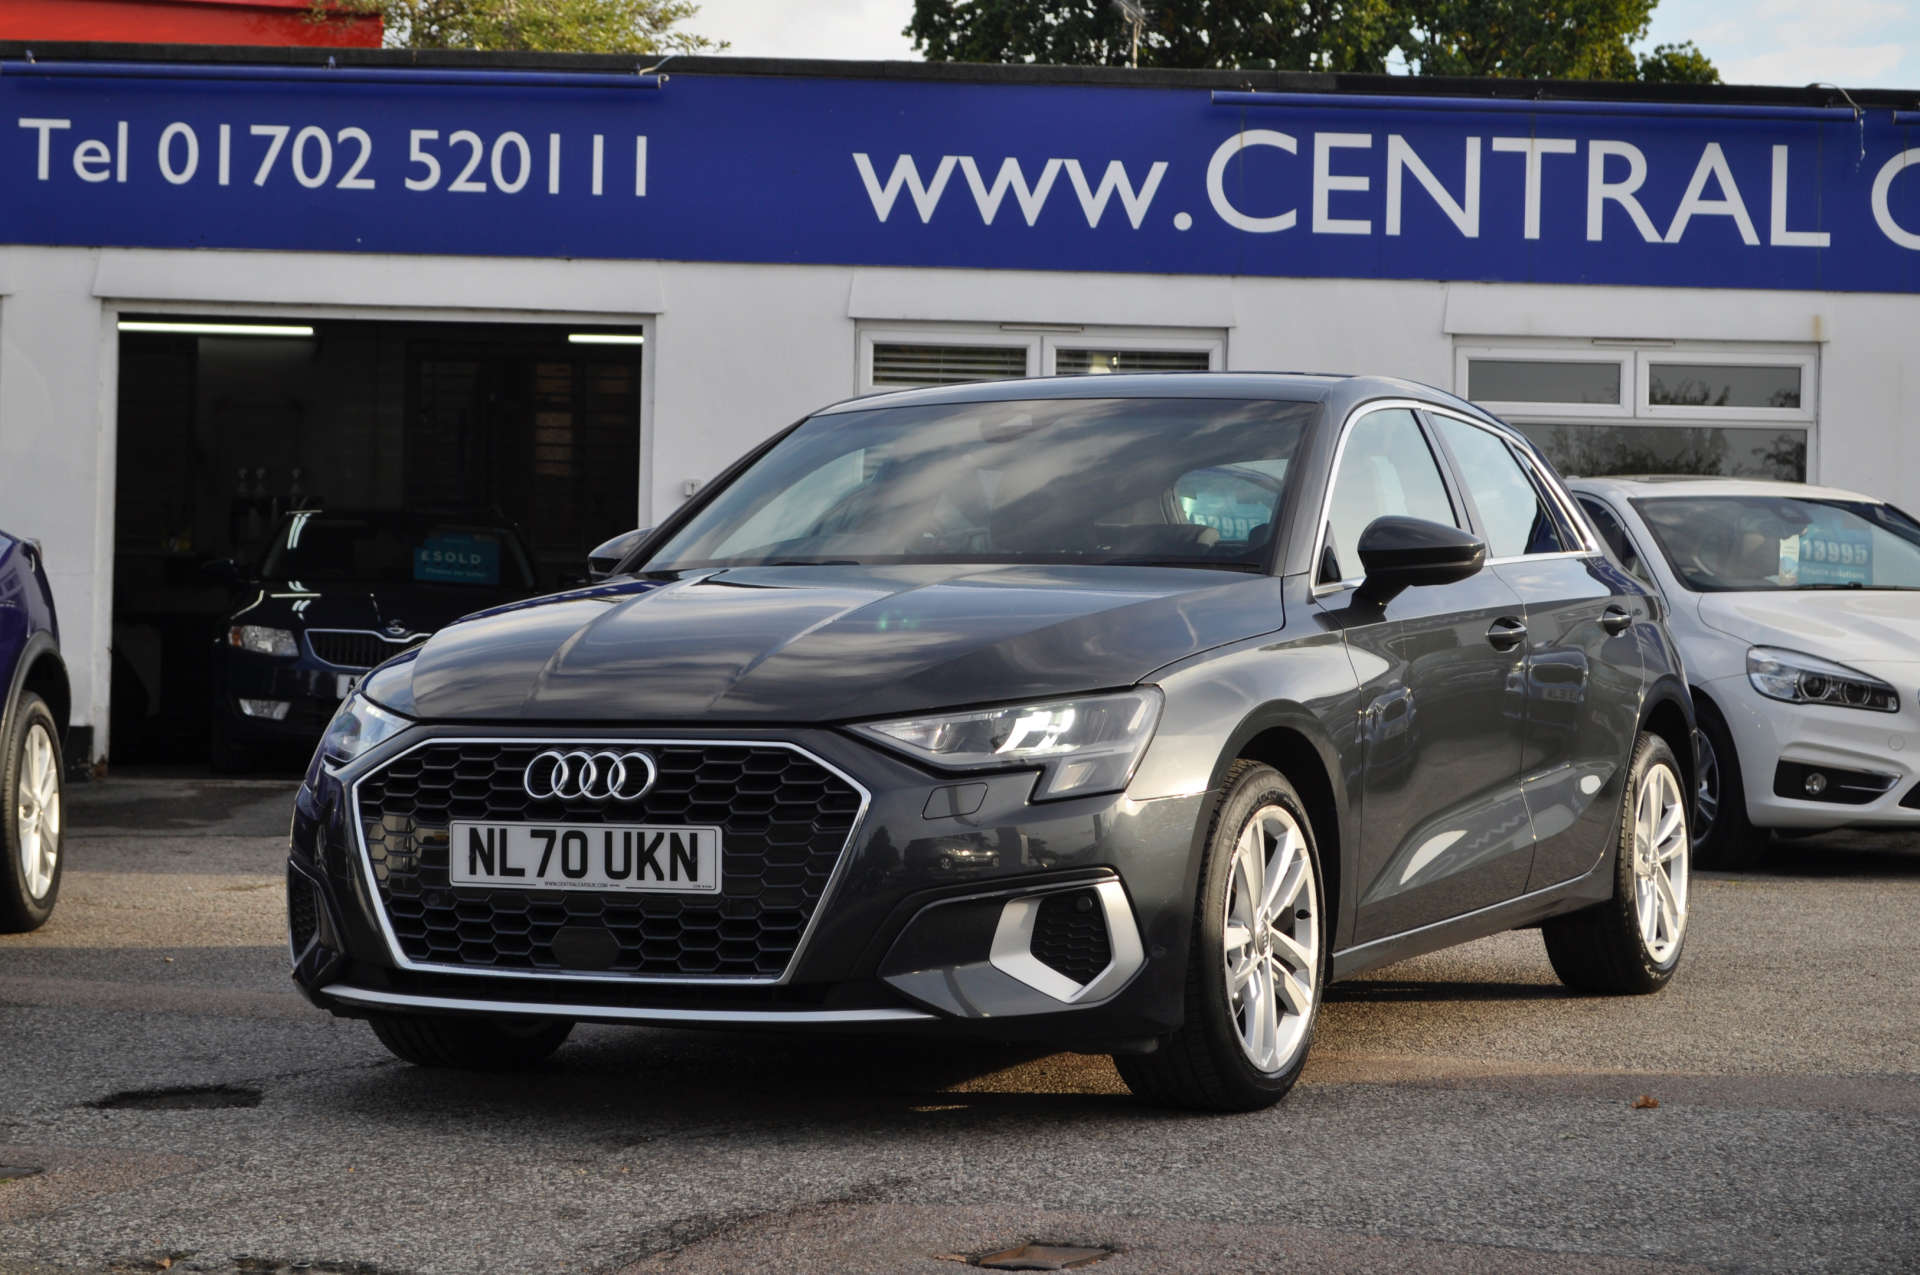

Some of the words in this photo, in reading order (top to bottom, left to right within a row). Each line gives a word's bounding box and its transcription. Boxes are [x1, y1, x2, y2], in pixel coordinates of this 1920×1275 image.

[19, 118, 129, 184] Tel
[158, 121, 376, 190] 01702
[404, 130, 648, 197] 520111
[468, 827, 589, 880] NL70
[604, 830, 699, 882] UKN
